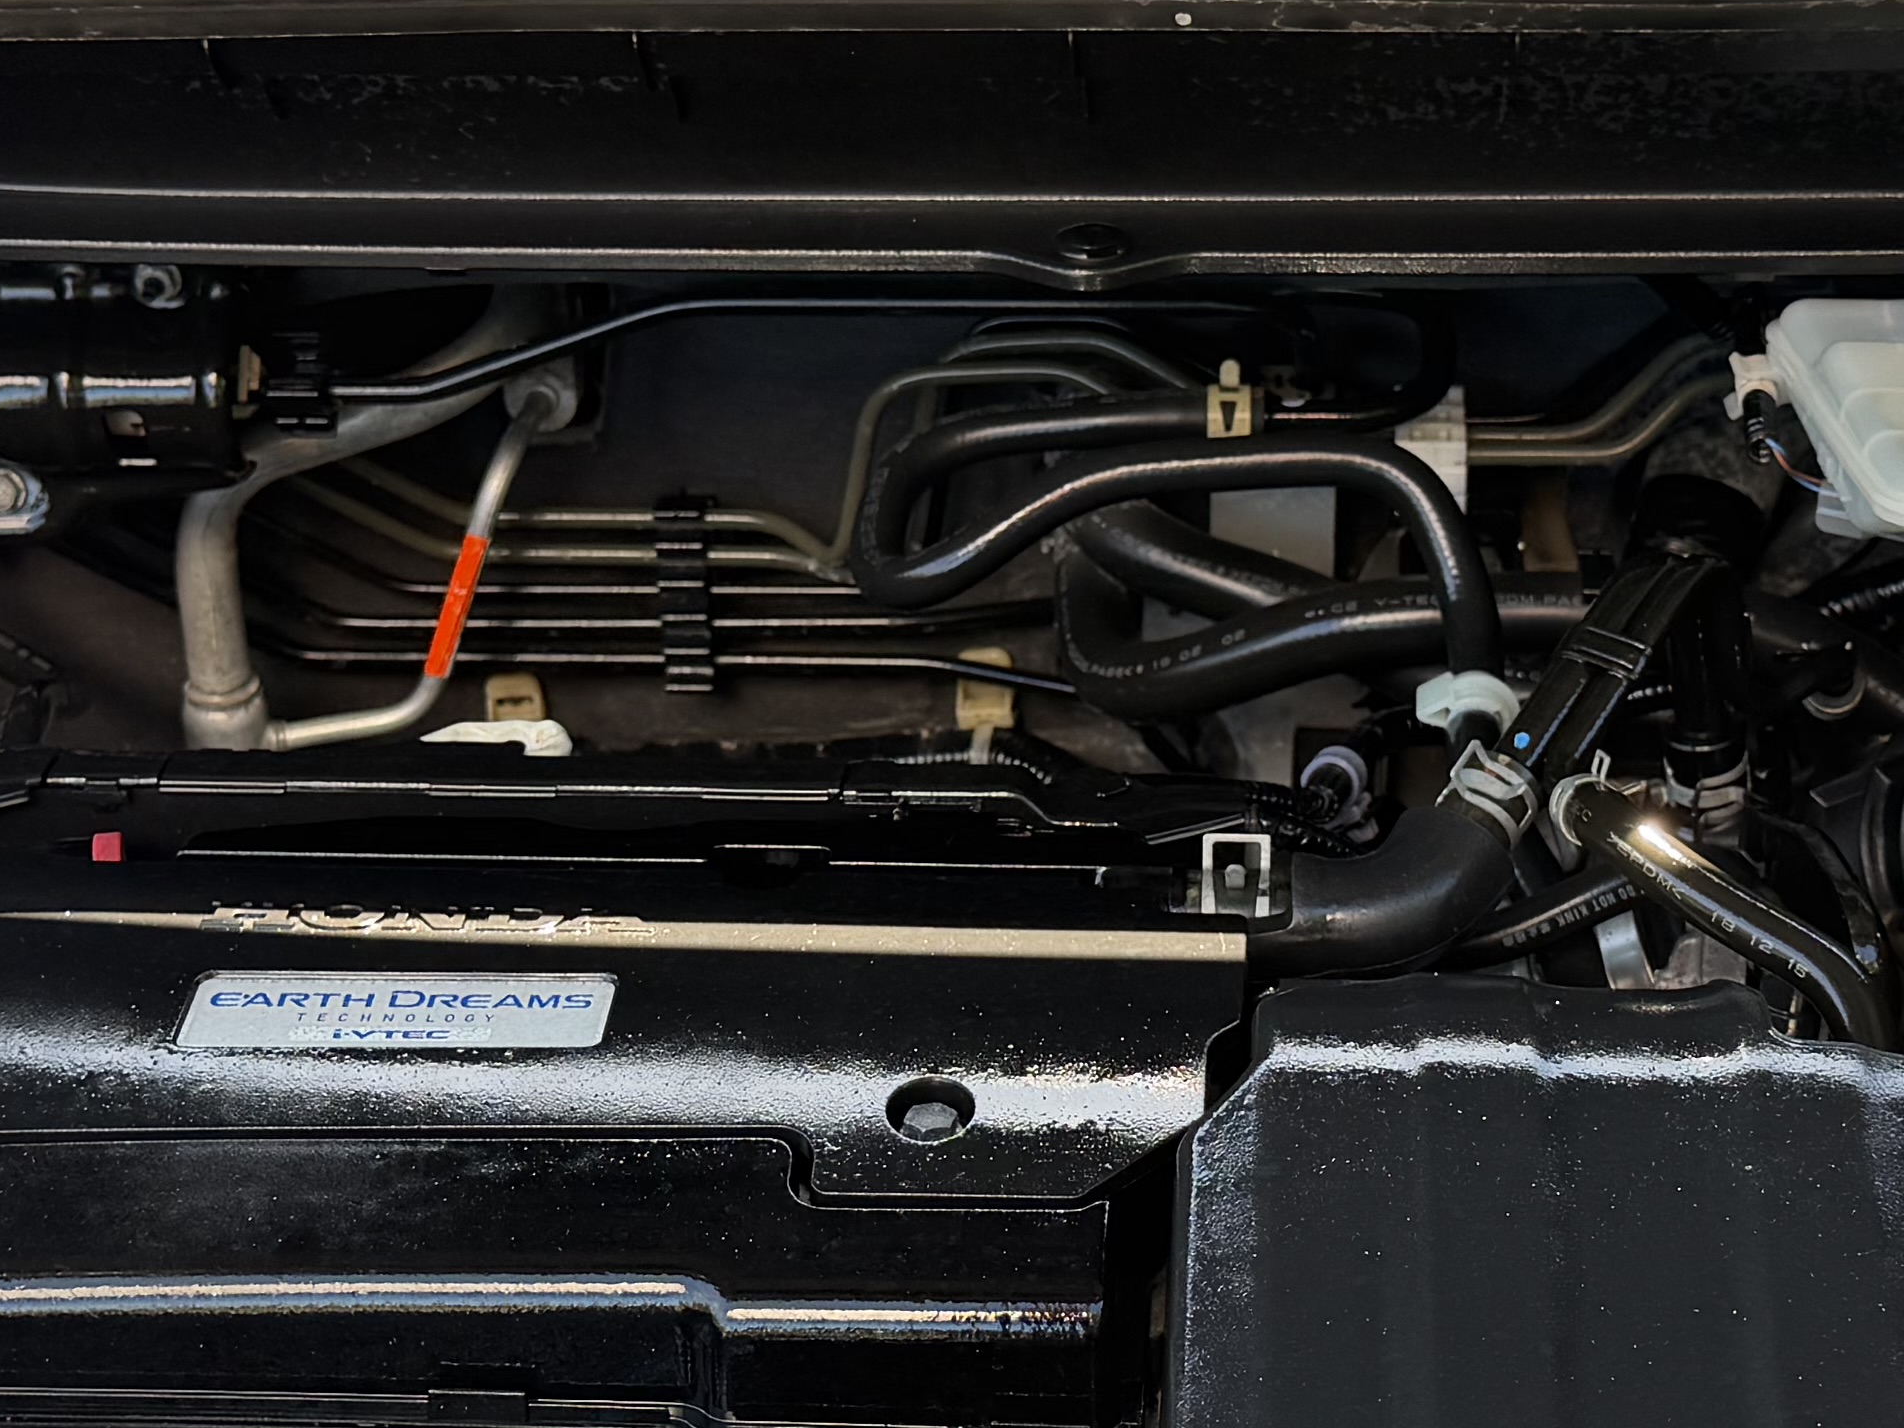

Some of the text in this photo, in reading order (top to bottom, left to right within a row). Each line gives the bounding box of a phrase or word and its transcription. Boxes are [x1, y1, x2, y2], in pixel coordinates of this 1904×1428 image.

[1590, 890, 1617, 912] NOT
[1556, 904, 1589, 929] KINK
[210, 989, 594, 1010] EARTH DREAMS
[296, 1012, 497, 1024] TECHNOLOGY
[331, 1027, 452, 1041] i-VTEC
